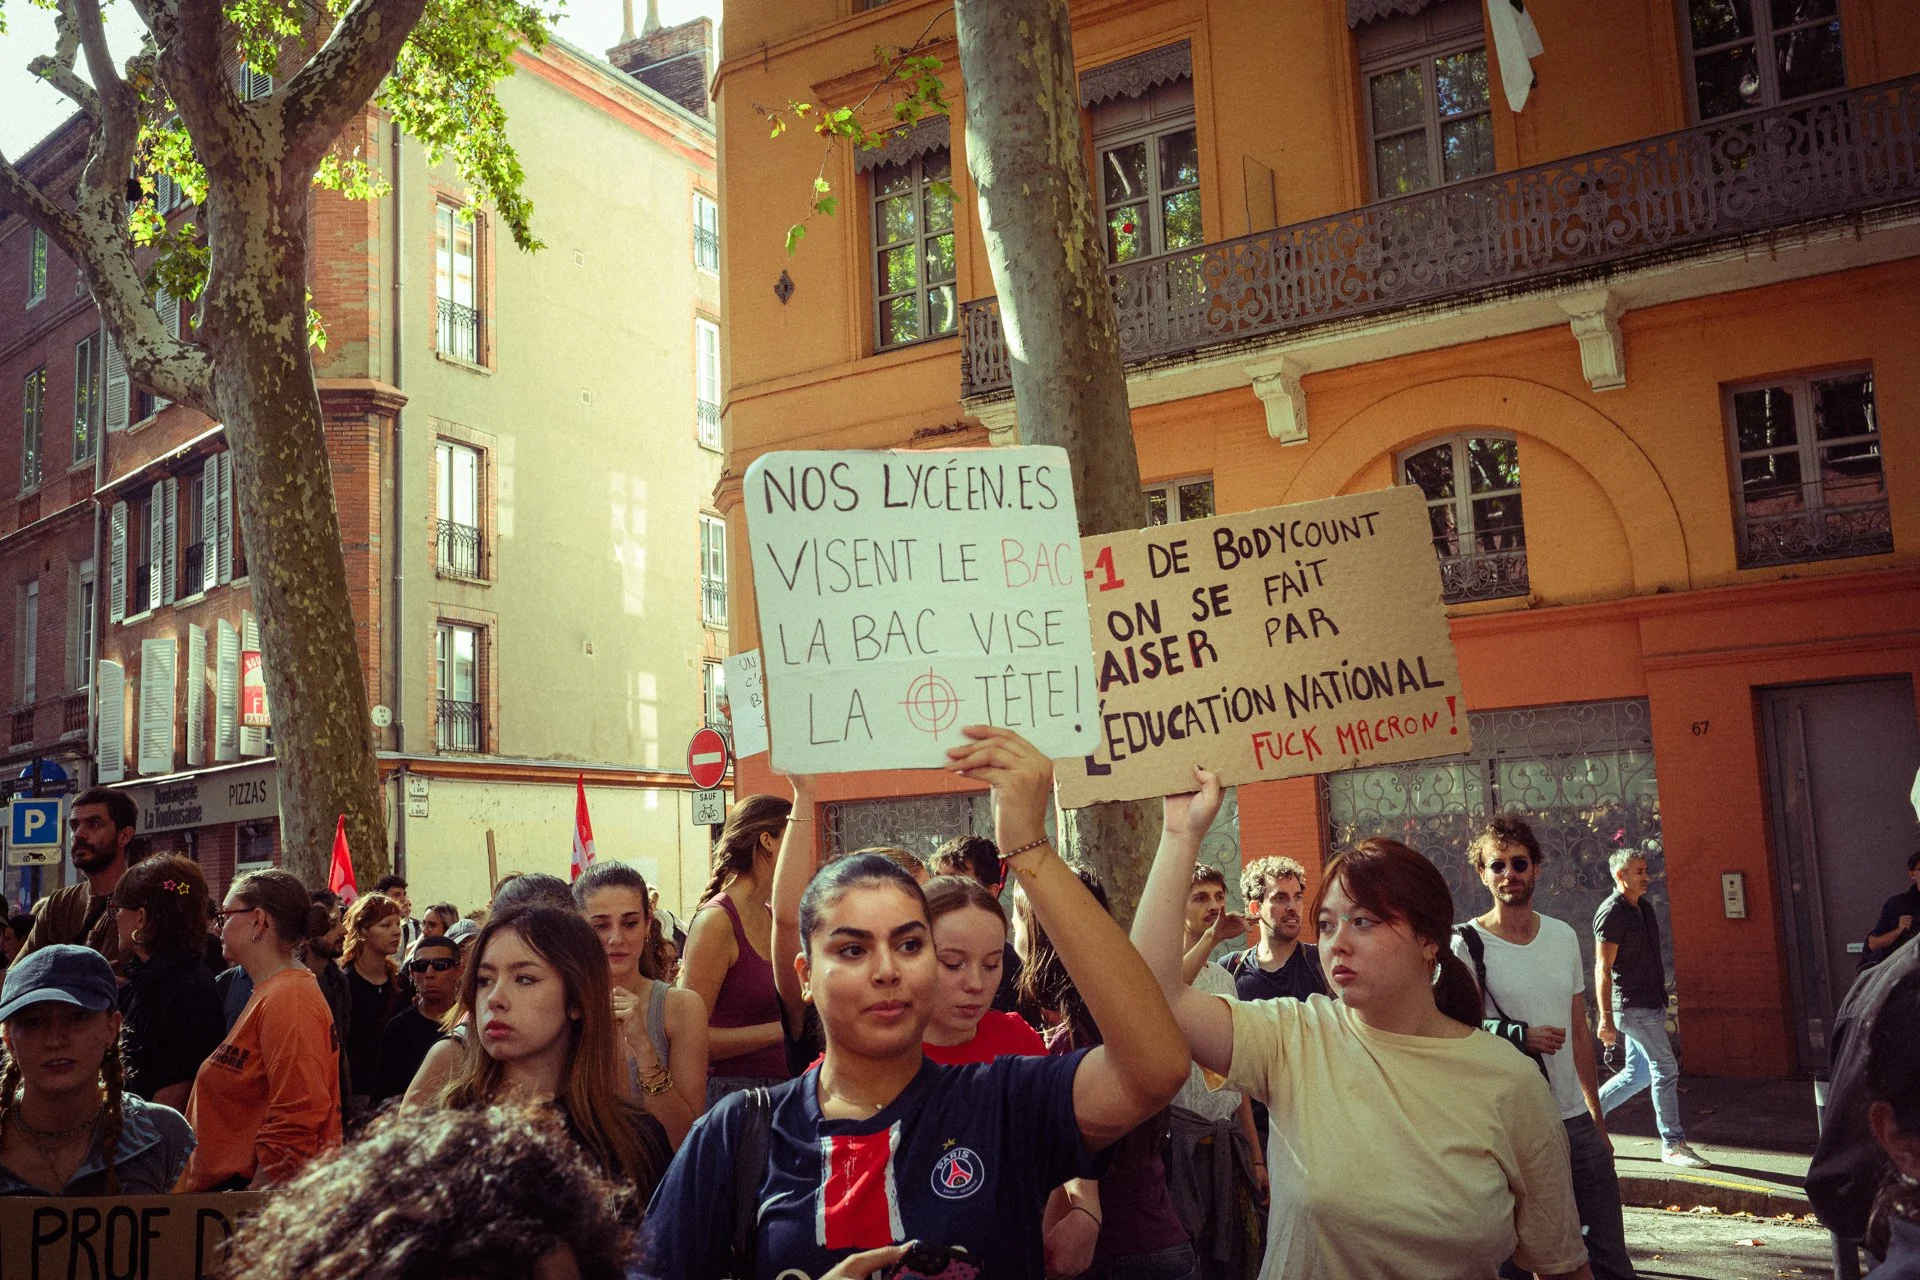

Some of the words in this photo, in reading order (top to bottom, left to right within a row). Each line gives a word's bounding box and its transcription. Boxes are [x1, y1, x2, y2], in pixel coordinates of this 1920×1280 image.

[763, 462, 859, 514] NOS
[884, 459, 1058, 511] LYCÉEN.ES
[767, 538, 917, 595] VISENT
[939, 543, 979, 583] LE
[1001, 539, 1073, 587] BAC
[1148, 540, 1190, 579] DE
[1107, 599, 1161, 642] ON
[1191, 584, 1232, 622] SE
[779, 618, 830, 664] LA
[852, 608, 938, 662] BAC
[970, 609, 1065, 655] VISE
[1095, 629, 1218, 693] AISER
[1265, 607, 1340, 647] PAR
[738, 656, 756, 671] UN
[810, 689, 873, 745] LA
[1692, 720, 1710, 736] 67
[1251, 725, 1322, 770] FUCK
[154, 783, 198, 806] Boulangerie
[229, 779, 267, 807] PIZZAS
[699, 791, 717, 802] SAUF
[24, 808, 47, 838] P
[145, 808, 154, 830] La
[155, 801, 203, 827] Toulousaine
[937, 1150, 969, 1169] PARIS
[31, 1206, 170, 1280] PROF
